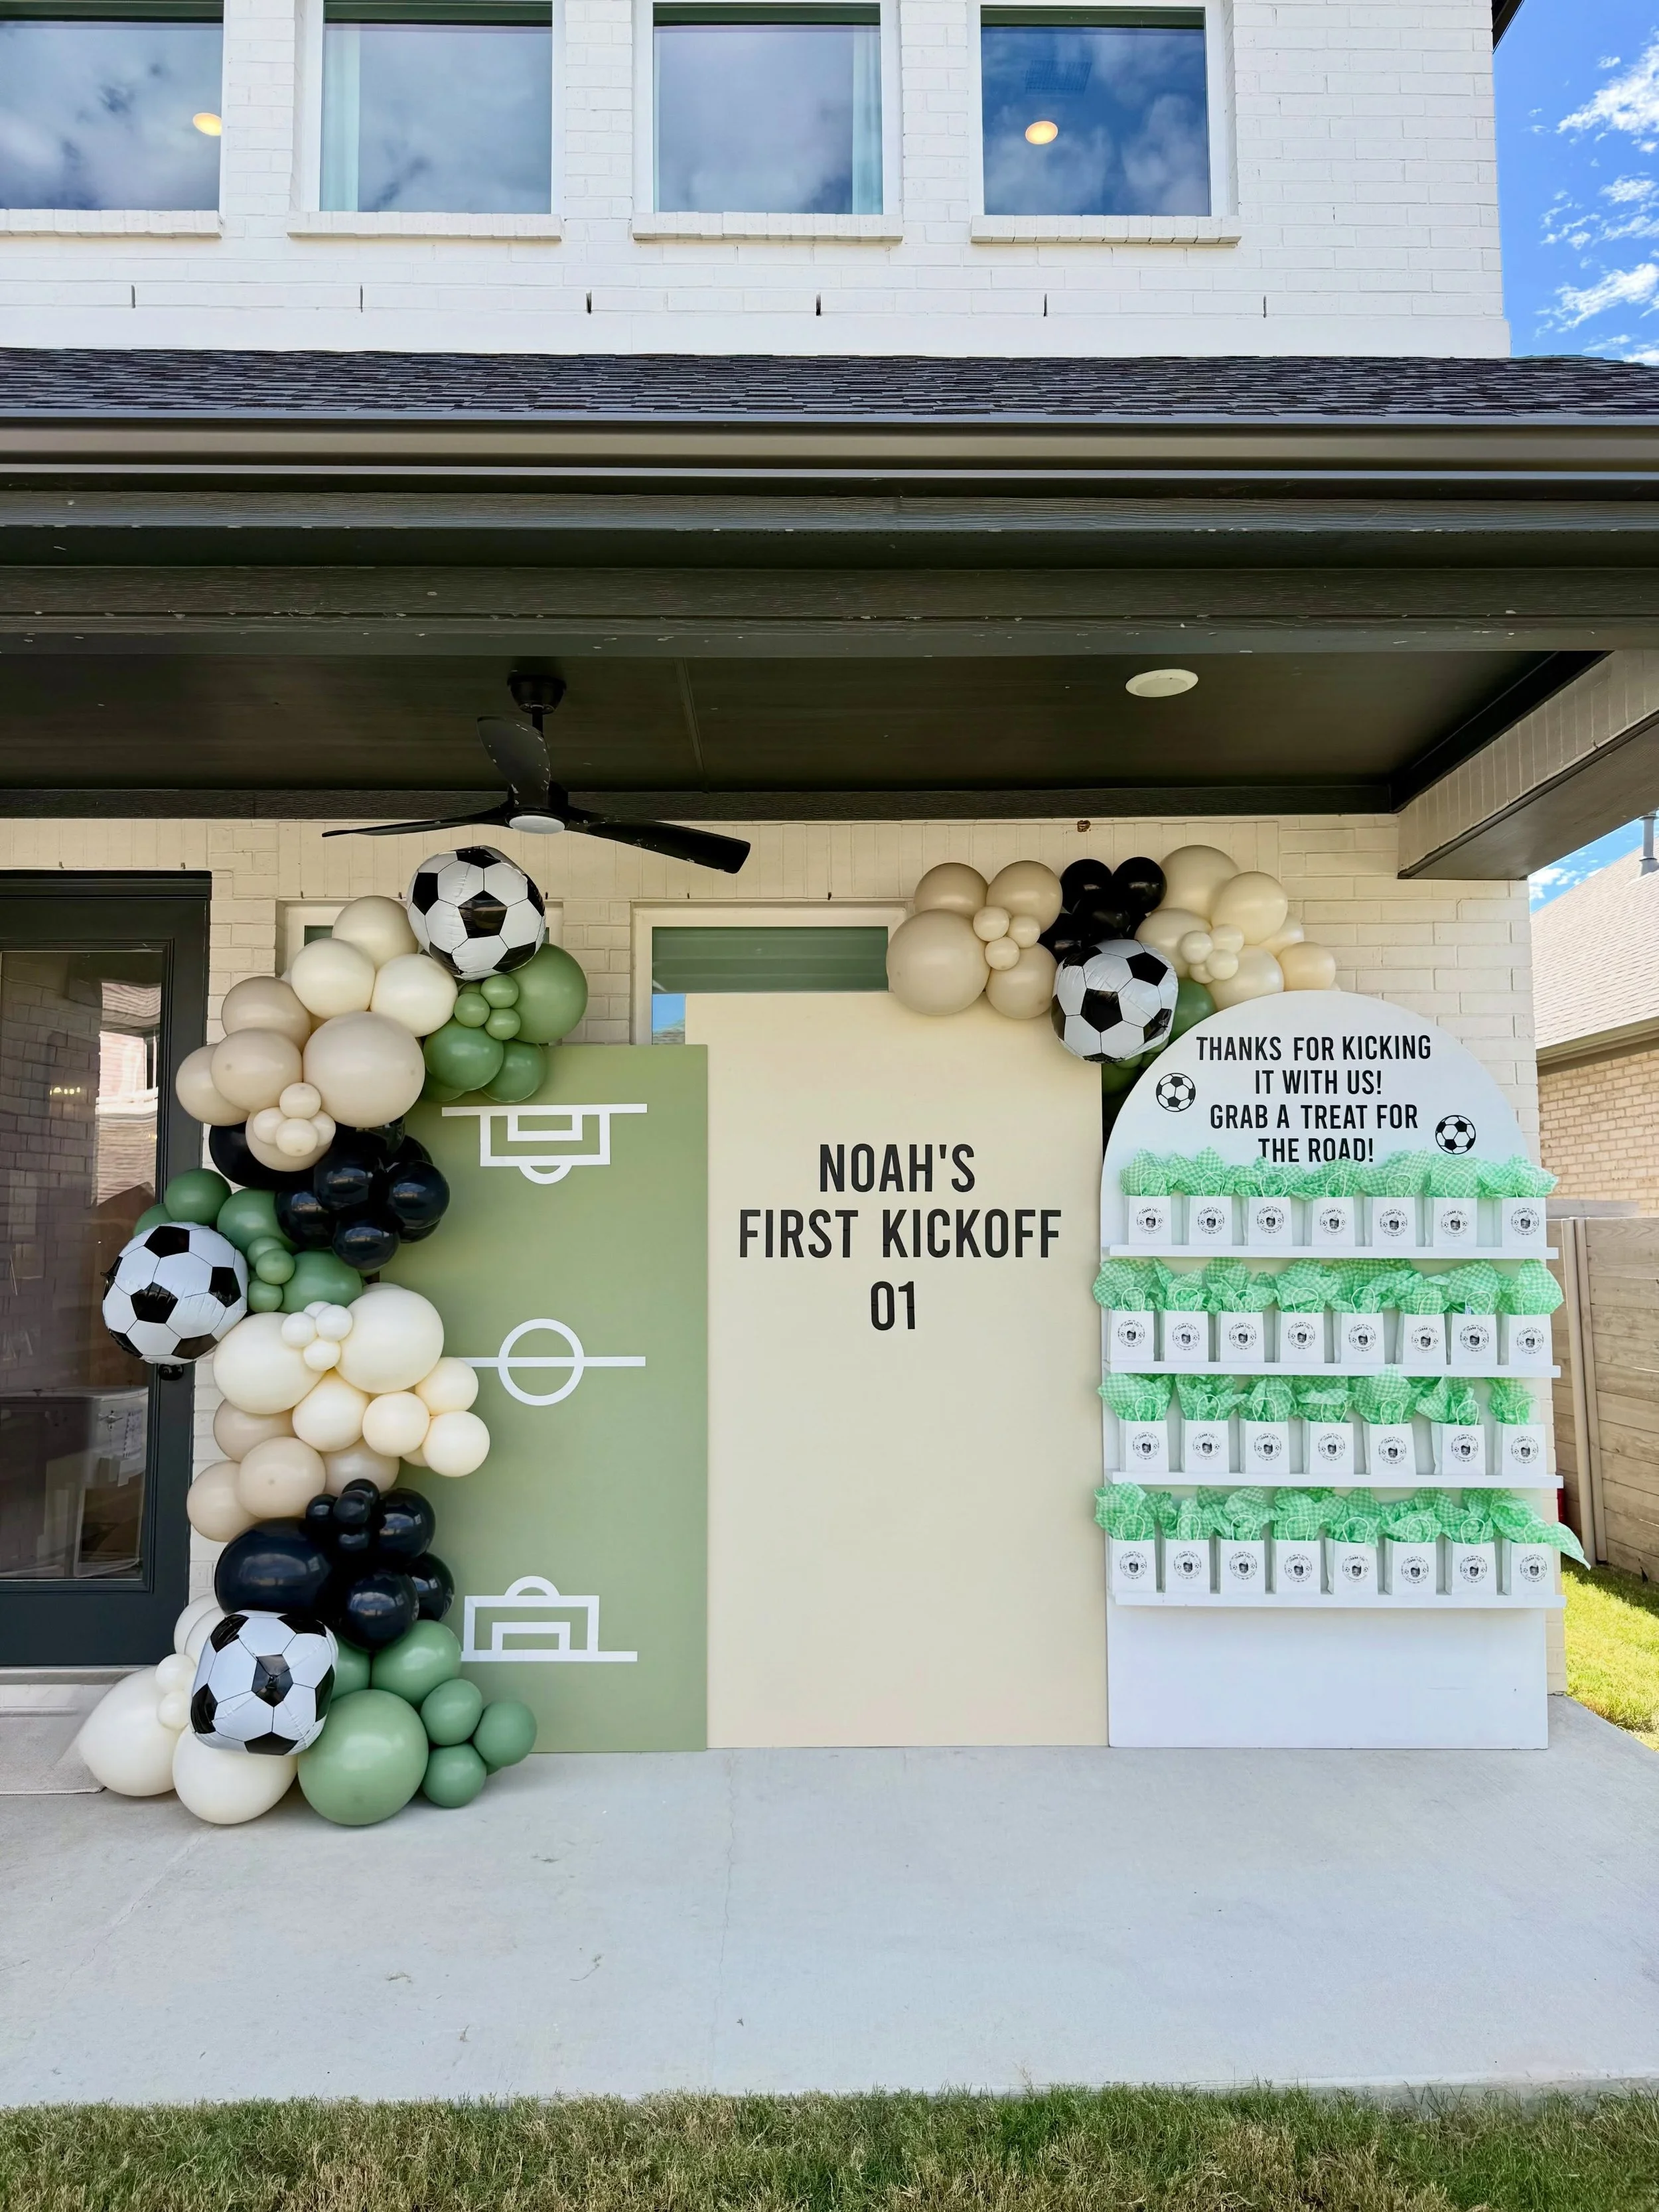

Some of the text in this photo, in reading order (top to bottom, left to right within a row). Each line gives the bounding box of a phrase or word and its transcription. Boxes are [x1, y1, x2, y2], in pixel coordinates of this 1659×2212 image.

[1196, 1035, 1430, 1061] THANKS FOR KICKING
[1256, 1070, 1381, 1094] IT WITH US!
[1211, 1104, 1417, 1129] GRAB A TREAT FOR
[1258, 1138, 1372, 1162] THE ROAD!
[820, 1143, 975, 1192] NOAH'S
[740, 1209, 1061, 1258] FIRST KICKOFF
[871, 1282, 915, 1331] 01
